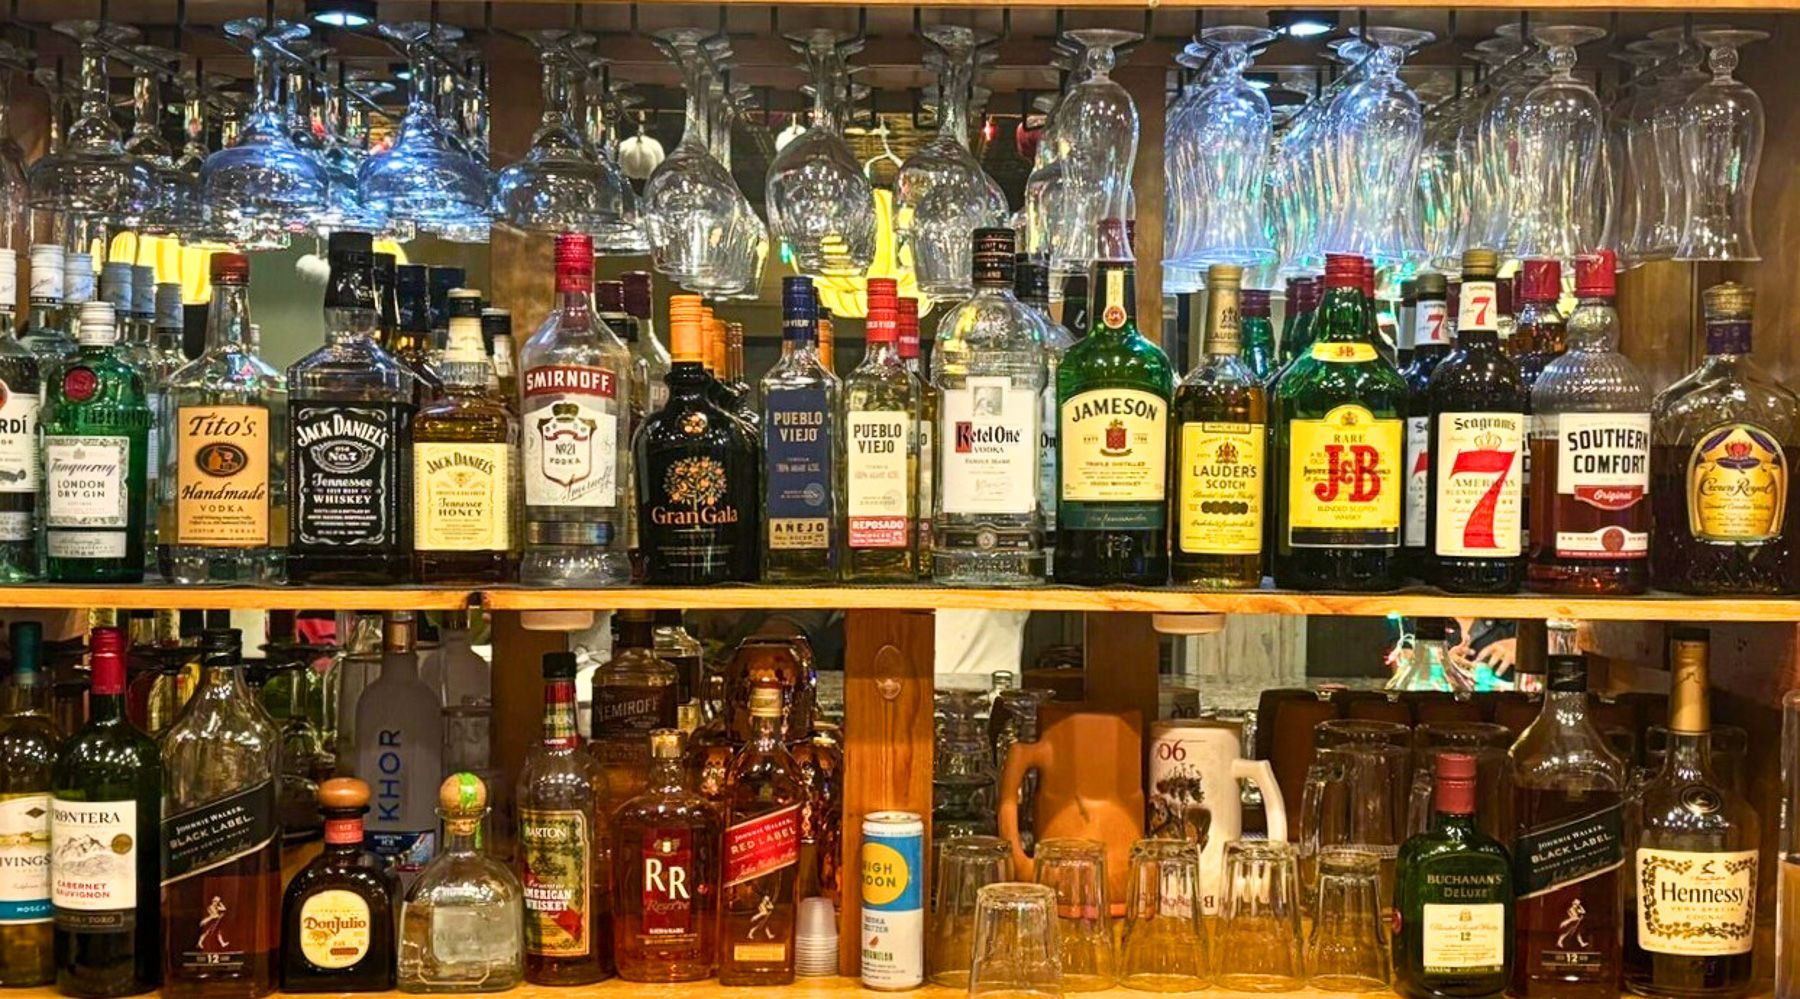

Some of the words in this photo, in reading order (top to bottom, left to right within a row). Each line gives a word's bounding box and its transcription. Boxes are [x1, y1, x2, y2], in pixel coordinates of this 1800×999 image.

[1472, 297, 1491, 325] 7
[1427, 314, 1444, 340] 7
[1072, 397, 1158, 423] JAMESON
[773, 411, 823, 426] PUEBLO
[1454, 418, 1517, 431] Seagram's
[296, 420, 332, 447] JACK
[333, 413, 390, 449] DANIEL'S
[779, 428, 819, 442] VIEJO
[853, 424, 902, 438] PUEBLO
[957, 424, 993, 448] Ketel
[995, 426, 1020, 443] One
[1333, 434, 1366, 443] RARE
[1568, 428, 1648, 452] SOUTHERN
[858, 440, 894, 453] VIEJO
[51, 458, 116, 476] Tanqueray
[426, 455, 452, 475] JACK
[550, 457, 581, 465] VODKA
[1574, 455, 1646, 474] COMFORT
[1193, 464, 1257, 478] LAUDER'S
[57, 480, 105, 489] LONDON
[312, 473, 373, 487] Tennessee
[1206, 480, 1246, 489] SCOTCH
[1700, 477, 1735, 496] Crown
[1736, 477, 1775, 496] Royal
[57, 490, 78, 498] DRY
[83, 490, 105, 498] GIN
[181, 481, 265, 500] Handmade
[1594, 487, 1632, 503] Original
[313, 495, 372, 504] WHISKEY
[439, 498, 482, 507] Tennessee
[1449, 448, 1517, 549] 7
[652, 506, 698, 525] Gran
[701, 506, 738, 525] Gala
[775, 520, 824, 532] AÑEJO
[852, 520, 904, 529] REPOSADO
[378, 729, 400, 822] KHOR
[53, 808, 121, 825] RONTERA
[176, 817, 210, 835] JOHNNIE
[169, 829, 209, 849] BLACK
[730, 839, 756, 856] RED
[758, 827, 797, 847] LABEL
[1538, 834, 1571, 850] JOHNNIE
[1531, 845, 1572, 864] BLACK
[58, 880, 107, 890] CABERNET
[1427, 874, 1502, 885] BUCHANAN'S
[56, 888, 110, 899] SAUVIGNON
[523, 888, 573, 900] AMERICAN
[1661, 881, 1745, 906] Hennessy
[525, 898, 569, 912] WHISKEY
[1461, 931, 1471, 941] 12
[207, 954, 220, 964] 12
[1566, 953, 1578, 963] 12
